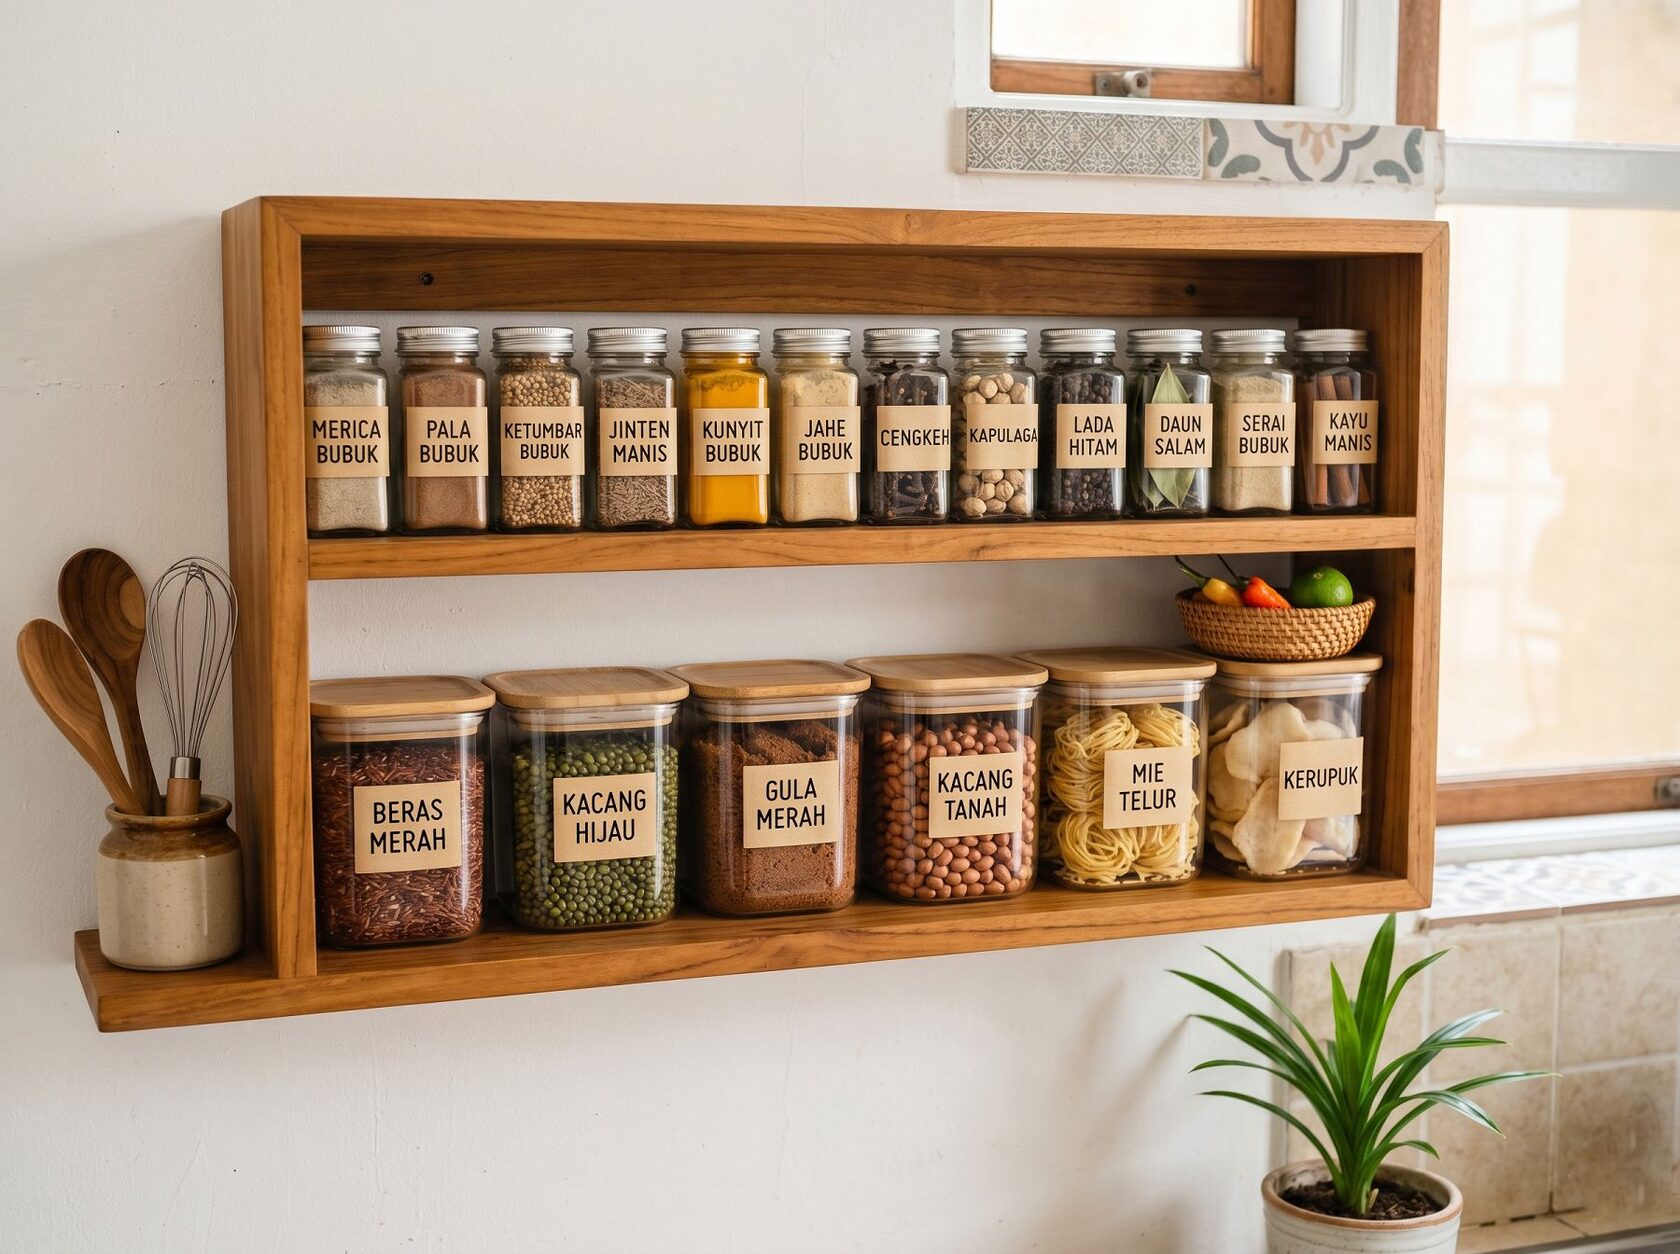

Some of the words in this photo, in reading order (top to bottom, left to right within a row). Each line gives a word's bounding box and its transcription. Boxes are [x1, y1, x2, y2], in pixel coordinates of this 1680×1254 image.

[312, 420, 382, 439] MERICA
[426, 419, 471, 439] PALA
[608, 420, 670, 439] JINTEN
[702, 420, 764, 440] KUNYIT
[804, 419, 846, 438] JAHE
[1074, 415, 1114, 434] LADA
[1160, 415, 1201, 433] DAUN
[1242, 414, 1285, 432] SERAI
[1329, 411, 1368, 430] KAYU
[504, 422, 583, 440] KETUMBAR
[880, 428, 951, 446] CENGKEH
[969, 428, 1039, 443] KAPULAGA
[520, 443, 570, 460] BUBUK
[798, 442, 853, 461] BUBUK
[1069, 438, 1118, 456] HITAM
[1154, 437, 1206, 455] SALAM
[1239, 436, 1289, 454] BUBUK
[1324, 433, 1373, 452] MANIS
[316, 444, 380, 464] BUBUK
[419, 444, 480, 464] BUBUK
[613, 443, 668, 463] MANIS
[705, 443, 761, 463] BUBUK
[938, 768, 1013, 794] KACANG
[1132, 762, 1164, 785] MIE
[1284, 765, 1358, 790] KERUPUK
[765, 777, 818, 802] GULA
[563, 789, 646, 816] KACANG
[944, 796, 1007, 821] TANAH
[1118, 788, 1177, 812] TELUR
[373, 798, 443, 825] BERAS
[756, 804, 825, 831] MERAH
[370, 827, 446, 855] MERAH
[576, 818, 635, 845] HIJAU
